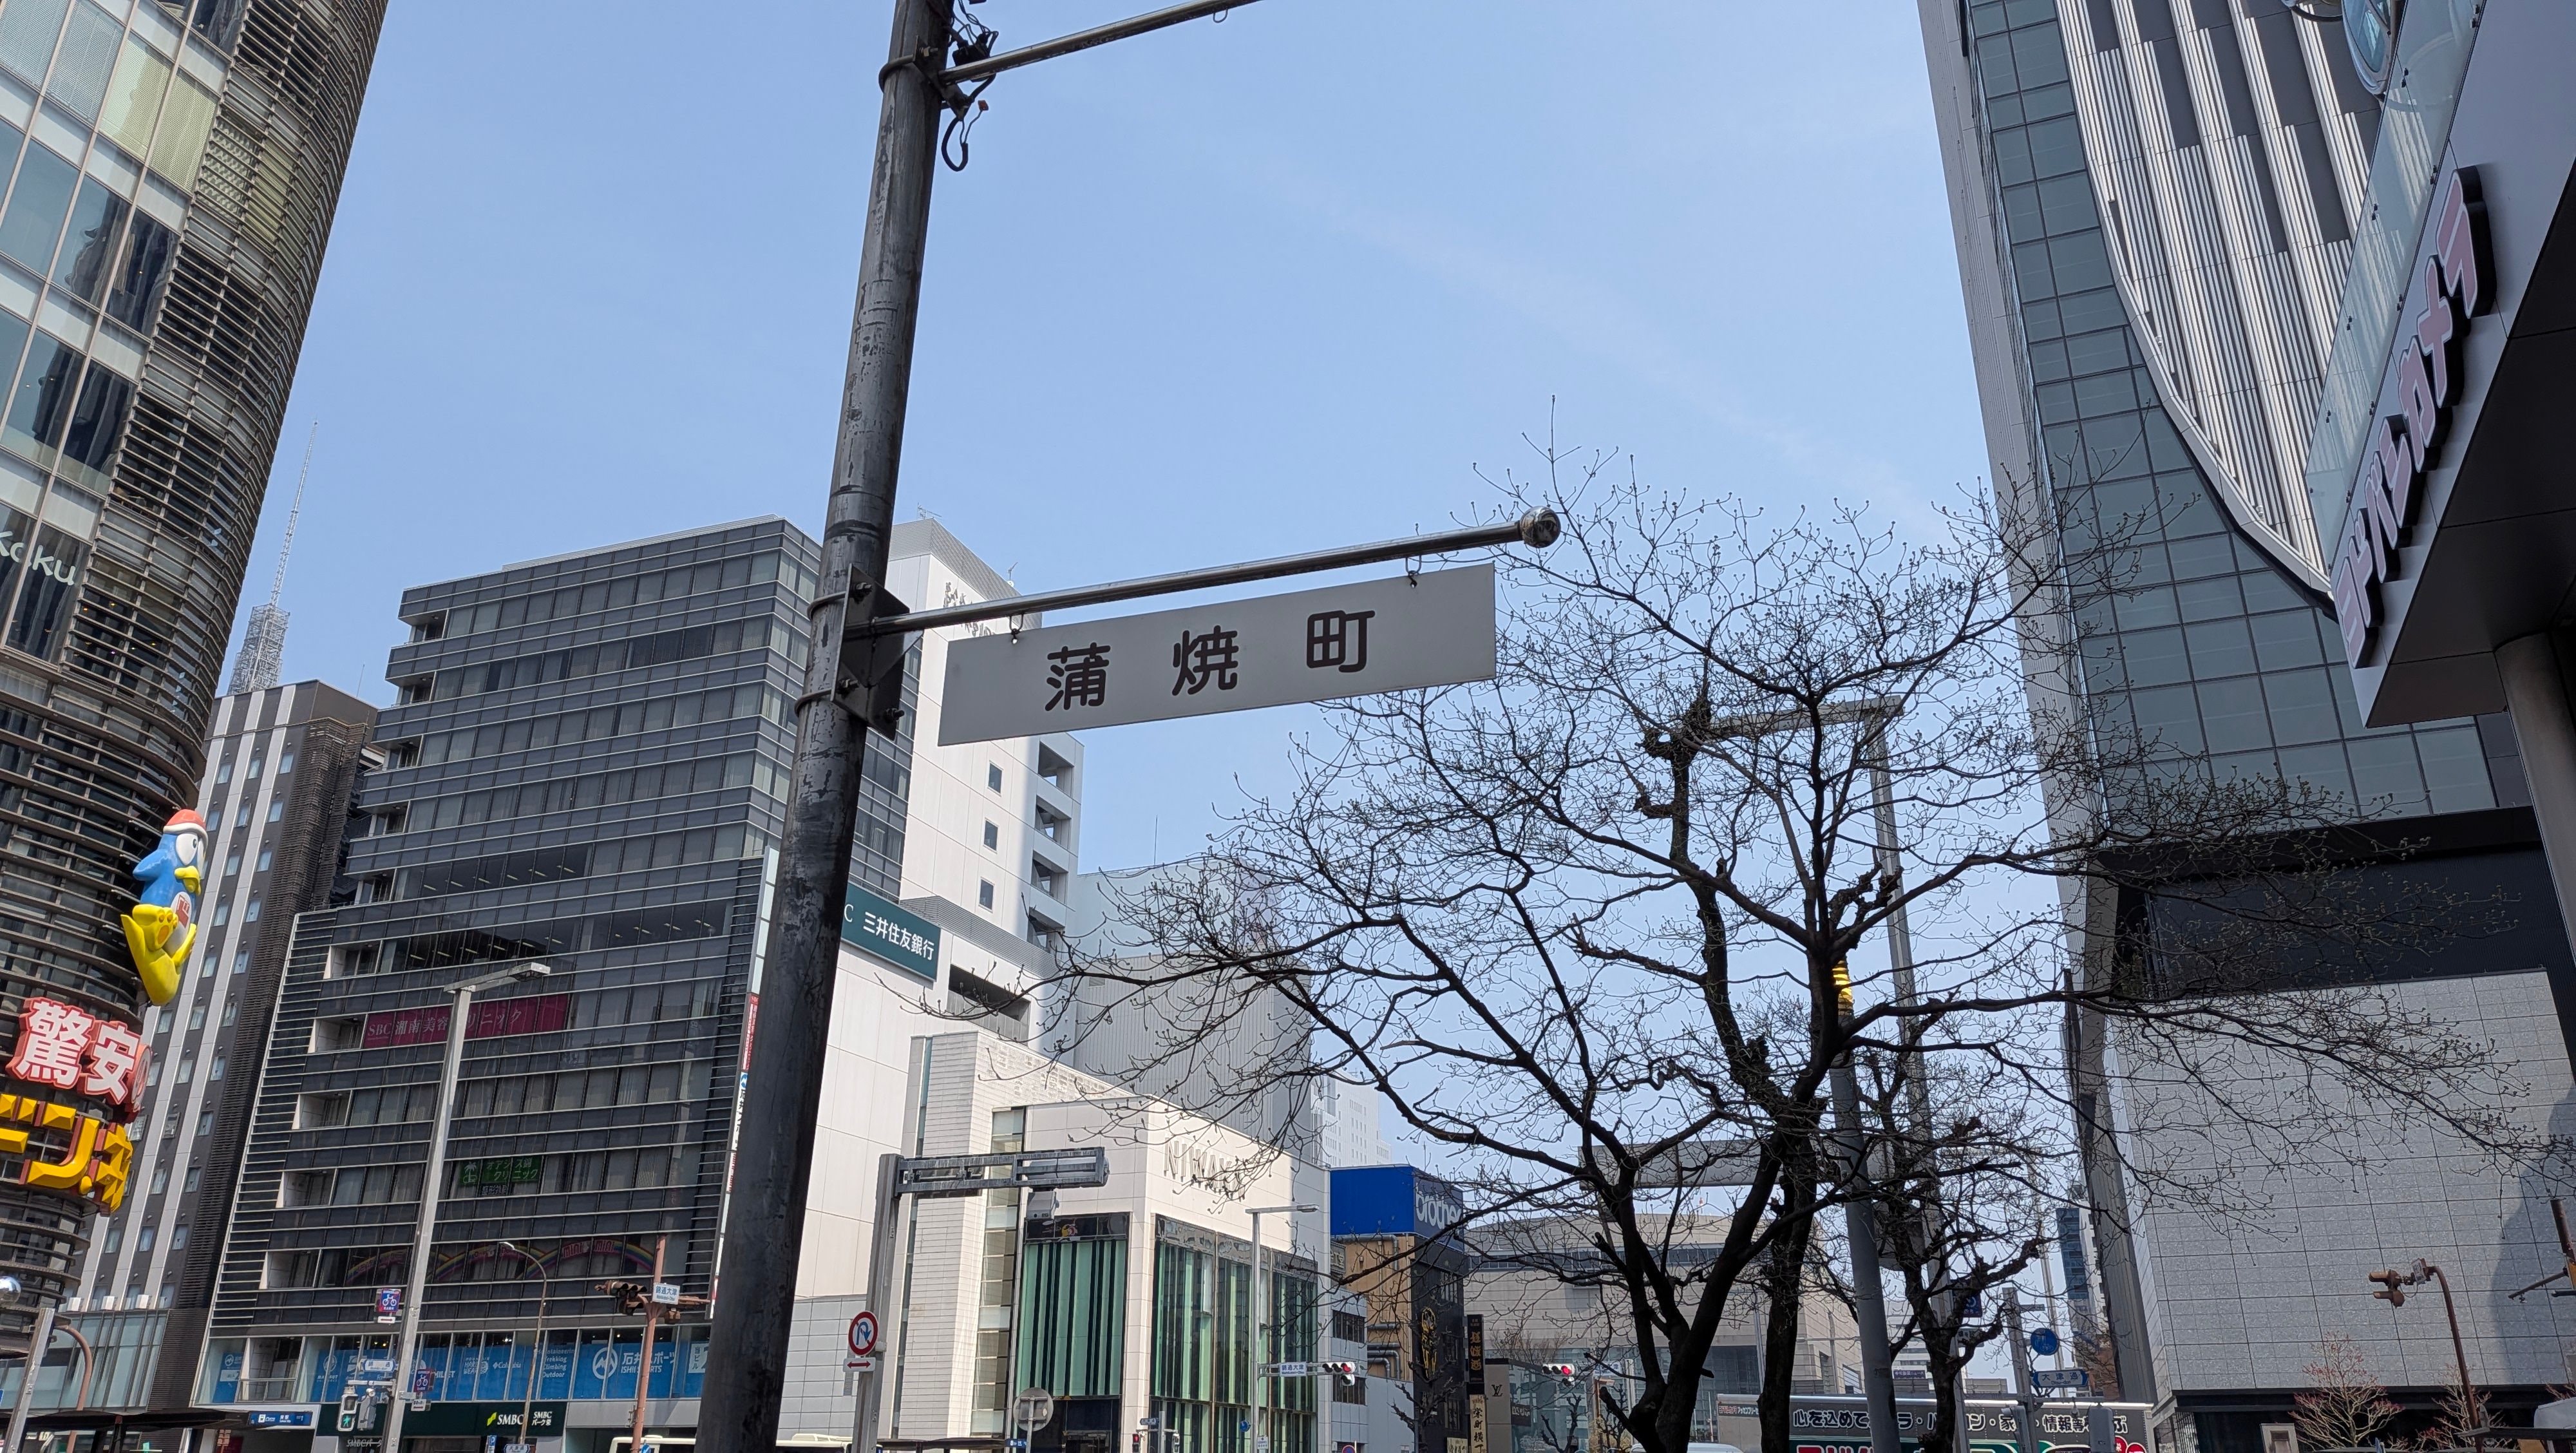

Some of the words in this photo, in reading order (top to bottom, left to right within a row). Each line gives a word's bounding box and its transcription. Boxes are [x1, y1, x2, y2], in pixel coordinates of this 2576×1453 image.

[2336, 166, 2481, 669] ヨドバシカメラ
[1045, 610, 1376, 712] 蒲焼町
[863, 911, 935, 961] 三井住友銀行
[368, 1023, 392, 1037] SBC
[395, 1009, 522, 1035] 湘南美容リニック
[1416, 1182, 1461, 1230] brother
[490, 1436, 495, 1445] P
[497, 1414, 524, 1425] SMBC
